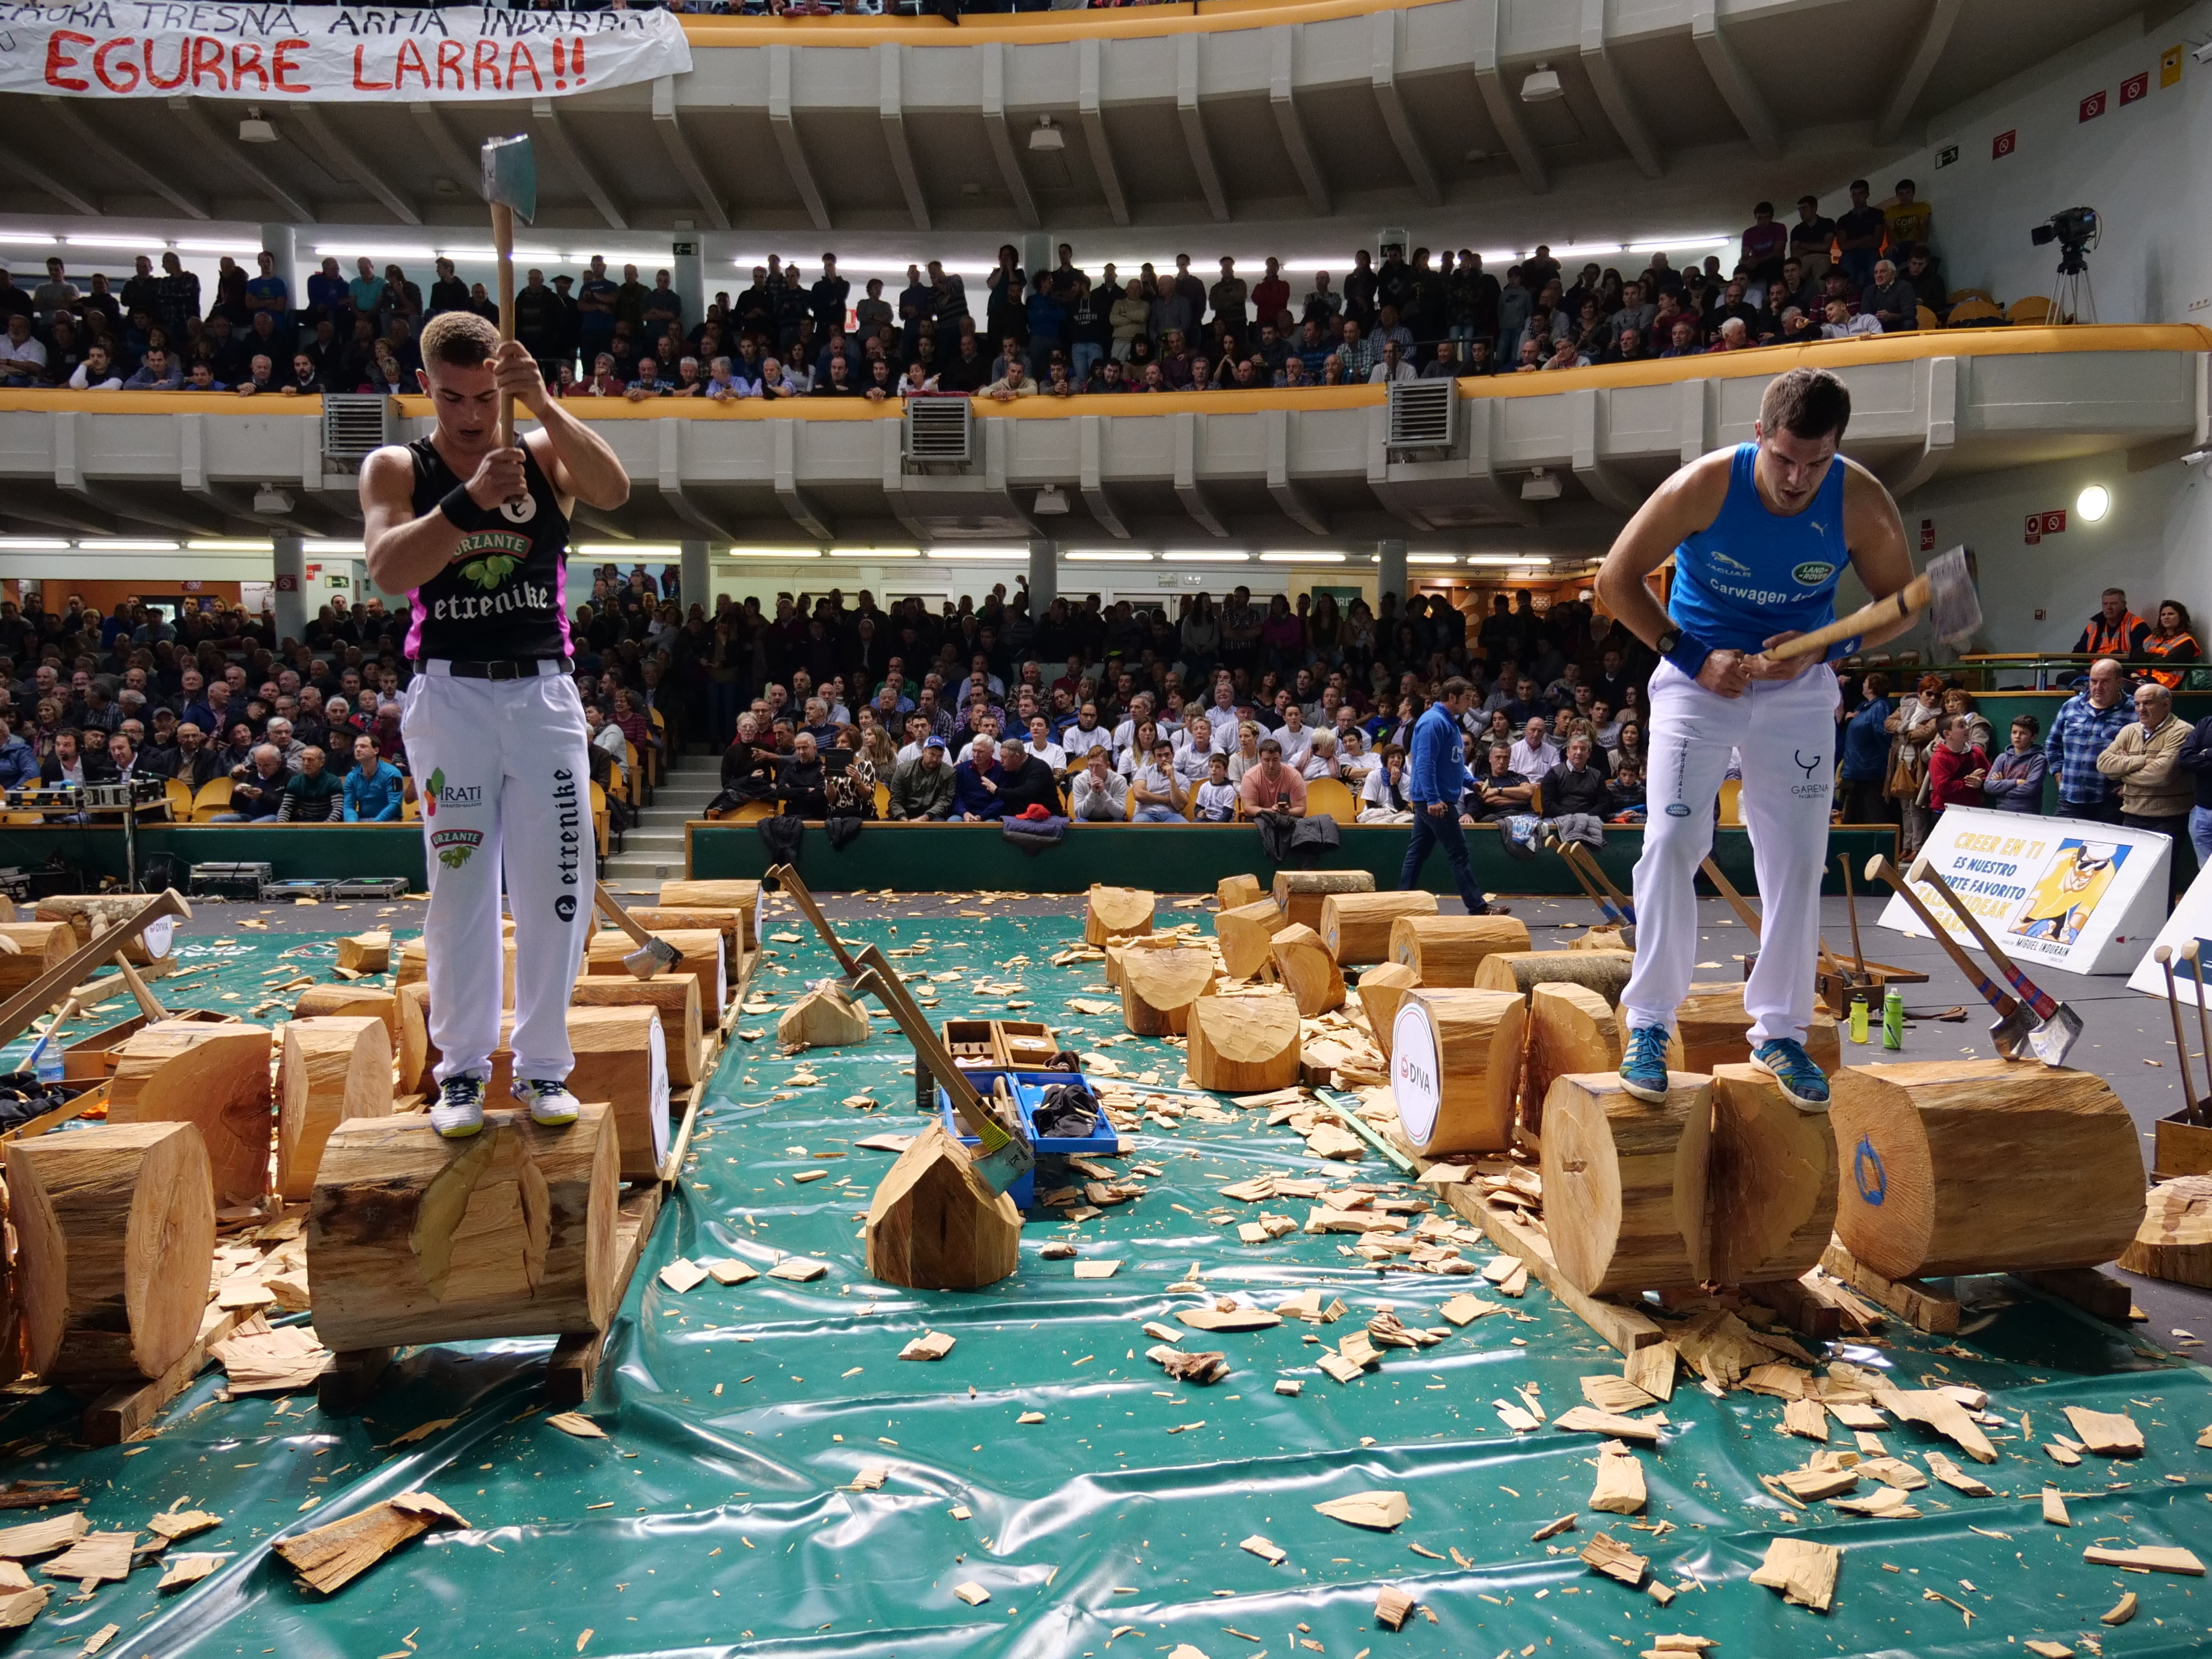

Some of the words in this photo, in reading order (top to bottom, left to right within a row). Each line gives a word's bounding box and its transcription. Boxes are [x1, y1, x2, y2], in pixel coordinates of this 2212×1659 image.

[44, 29, 311, 93] EGURRE
[353, 37, 587, 92] LARRA!!
[434, 581, 548, 620] etxenike
[1710, 578, 1787, 605] Carwagen
[1791, 784, 1829, 794] GARENA
[433, 832, 479, 845] URZANTE
[552, 768, 579, 885] etxenike
[1954, 832, 2002, 854] CREER
[1999, 837, 2026, 857] EN
[2026, 842, 2046, 860] TI
[1952, 856, 1968, 869] ES
[1966, 858, 2018, 877] NUESTRO
[1969, 881, 2026, 900] FAVORITO
[156, 923, 169, 932] DIVA
[2015, 937, 2039, 951] MIGUEL
[2038, 942, 2071, 958] INDURAIN
[1410, 1062, 1431, 1095] DIVA
